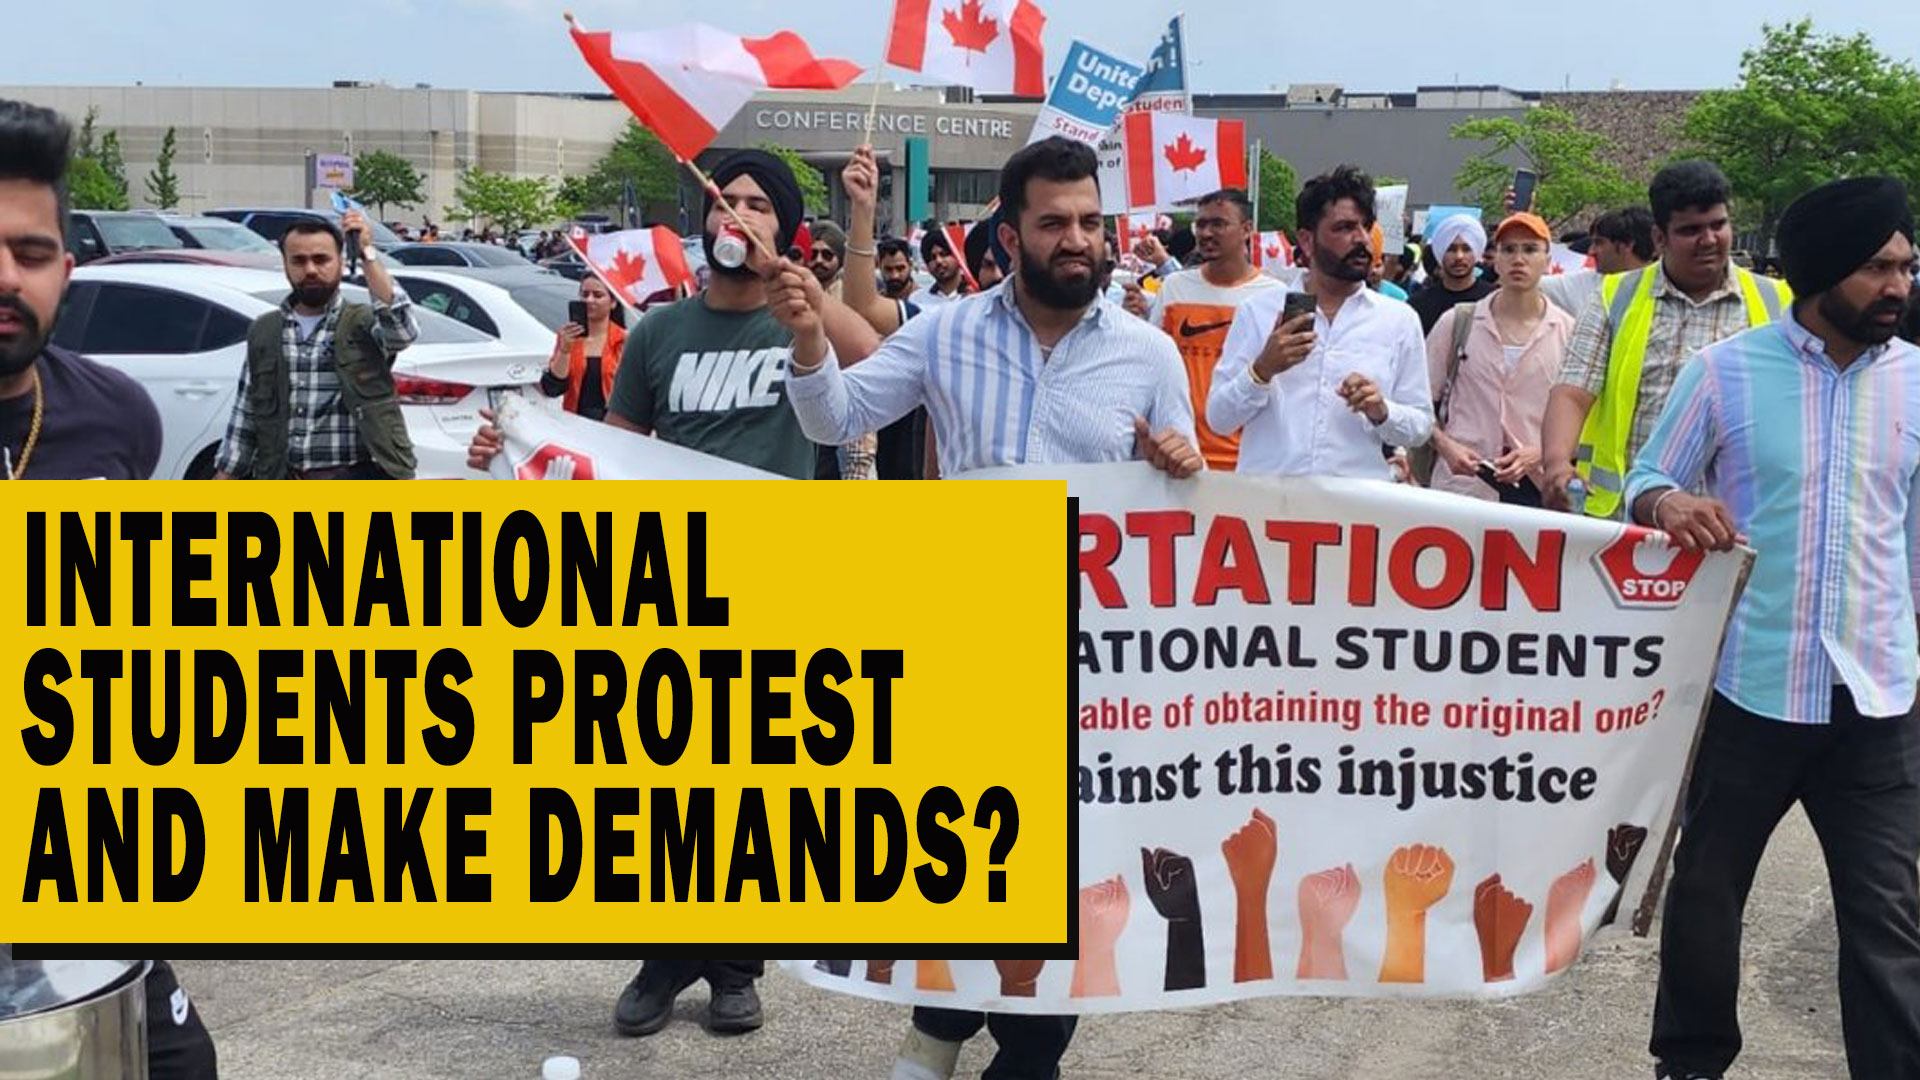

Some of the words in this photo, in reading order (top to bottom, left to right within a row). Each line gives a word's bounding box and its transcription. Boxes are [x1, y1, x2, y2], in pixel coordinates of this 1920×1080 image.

[755, 109, 927, 133] CONFERENCE
[936, 116, 1012, 138] CENTRE
[668, 347, 787, 412] NIKE
[1622, 578, 1687, 597] STOP
[1335, 626, 1665, 679] STUDENTS
[1080, 697, 1151, 731] able
[1163, 694, 1194, 728] of
[1204, 690, 1361, 732] obtaining
[1374, 693, 1430, 727] the
[1443, 697, 1581, 738] original
[1595, 688, 1665, 734] one?
[1215, 743, 1322, 796] this
[1338, 744, 1598, 811] injustice
